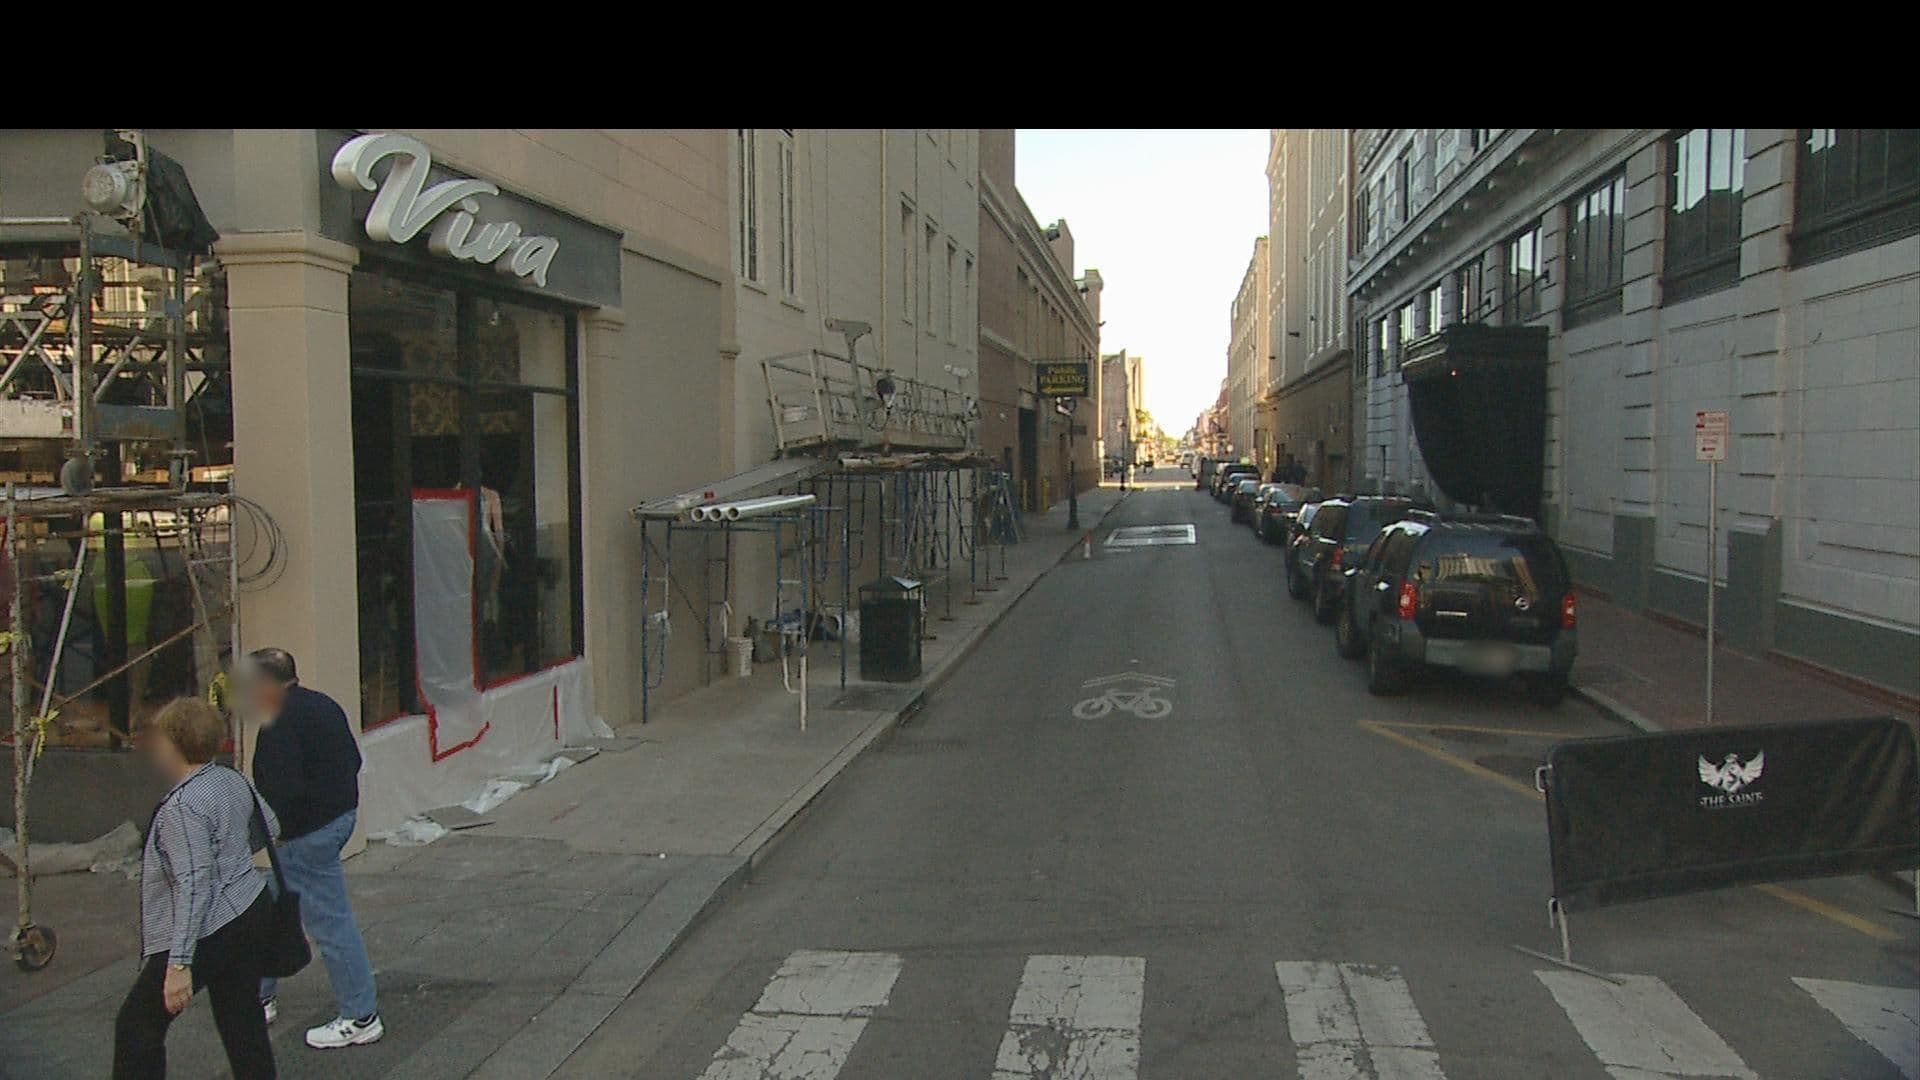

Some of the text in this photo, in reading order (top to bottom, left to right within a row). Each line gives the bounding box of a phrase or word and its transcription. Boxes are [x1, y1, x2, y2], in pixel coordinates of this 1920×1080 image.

[332, 133, 559, 288] Viva
[1040, 375, 1086, 385] PARKING
[1700, 791, 1763, 807] THE SAINT
